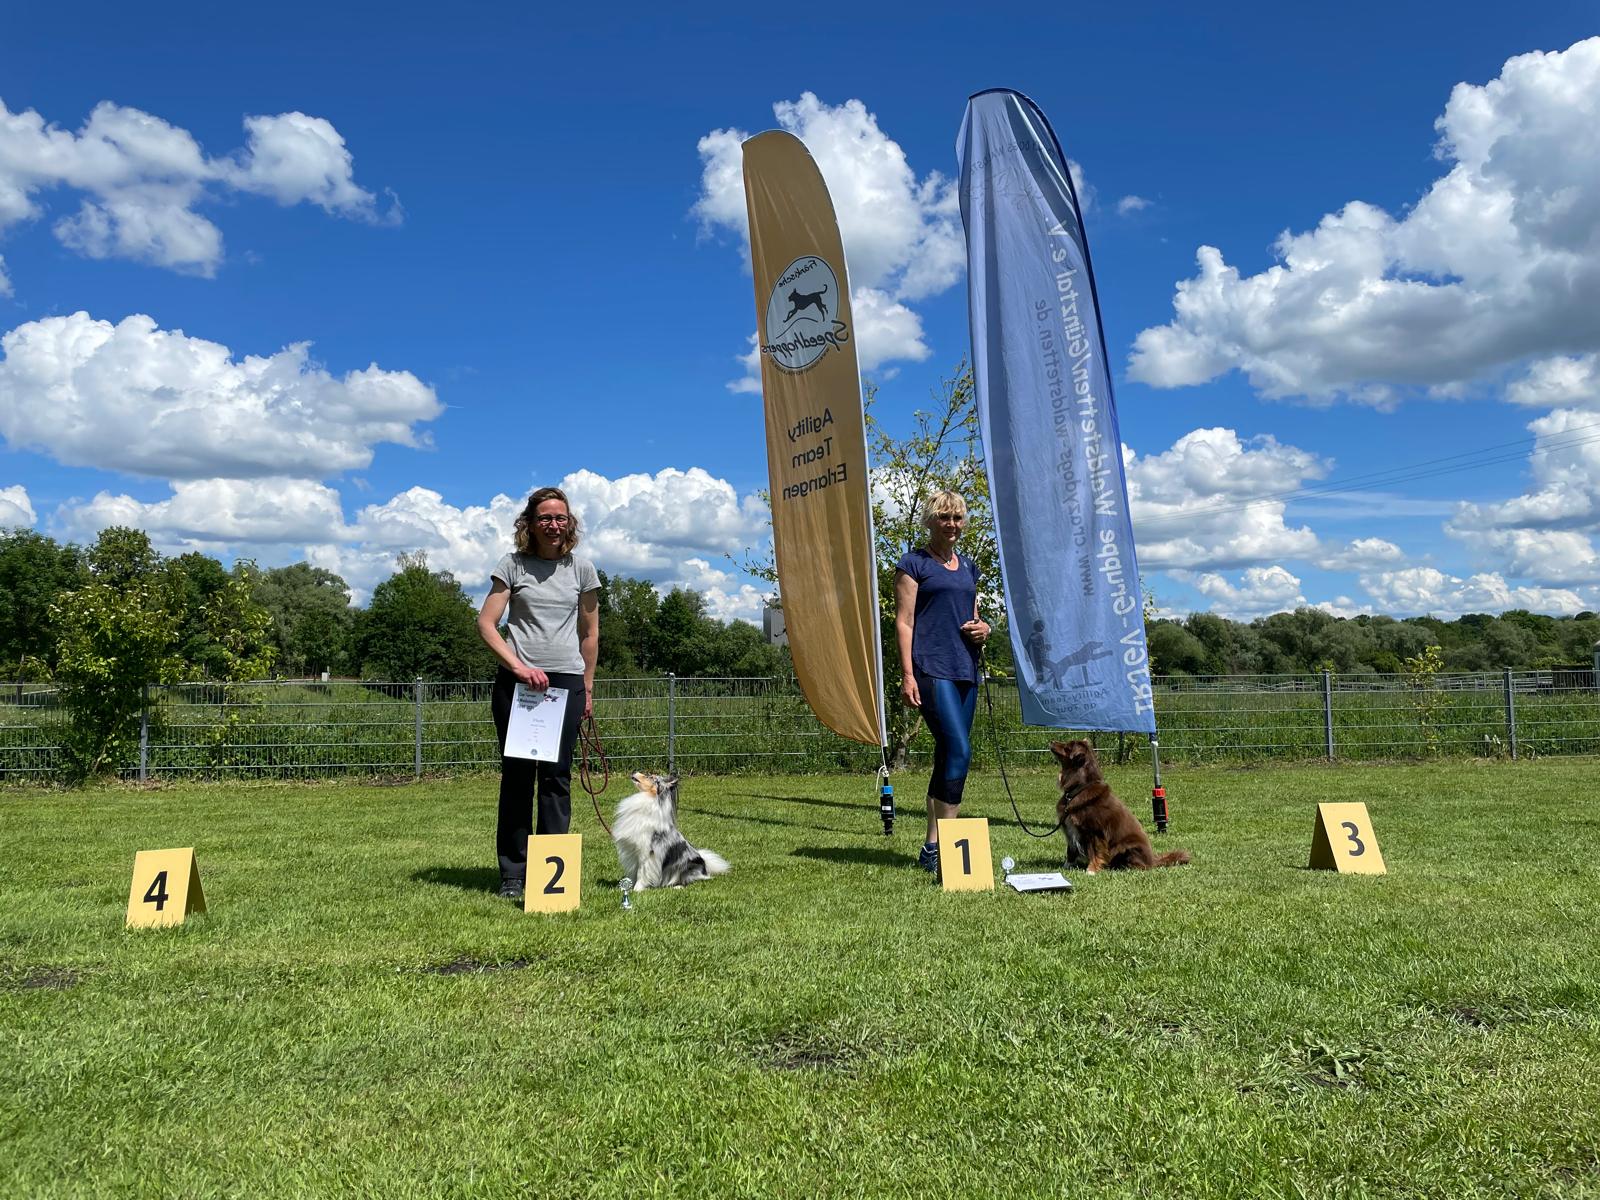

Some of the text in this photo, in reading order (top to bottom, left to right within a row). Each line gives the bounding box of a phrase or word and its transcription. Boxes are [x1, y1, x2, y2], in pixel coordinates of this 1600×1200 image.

[954, 838, 971, 875] 1
[1341, 821, 1365, 857] 3
[143, 870, 169, 911] 4
[543, 856, 565, 894] 2
